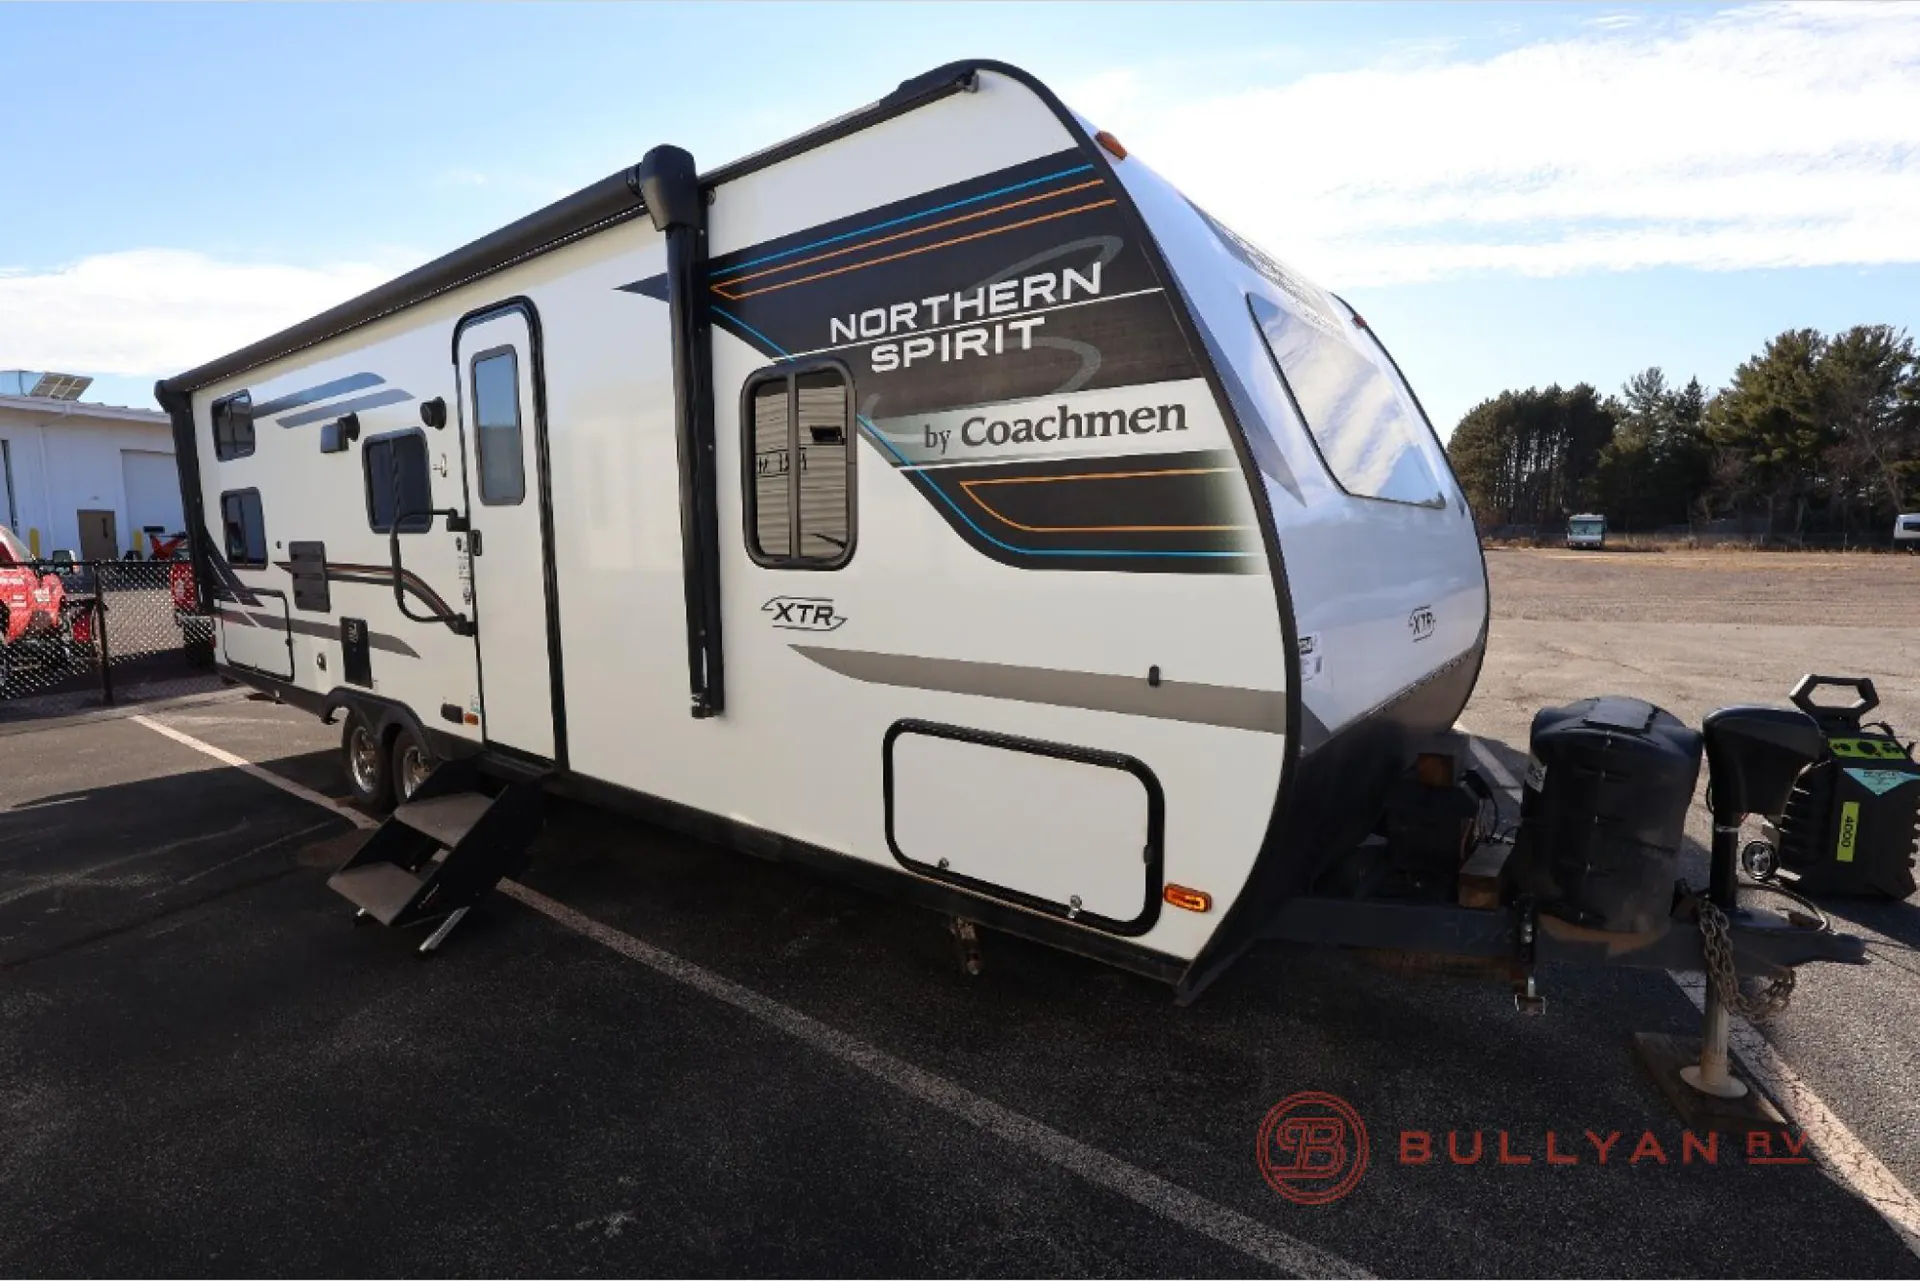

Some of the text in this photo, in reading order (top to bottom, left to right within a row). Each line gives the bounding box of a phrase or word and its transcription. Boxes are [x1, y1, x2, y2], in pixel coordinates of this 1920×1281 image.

[830, 262, 1102, 343] NORTHERN
[871, 317, 1045, 373] SPIRIT
[925, 403, 1188, 454] by Coachmen
[772, 602, 833, 626] XTR
[1412, 611, 1434, 635] XTR
[1841, 815, 1854, 848] 4000
